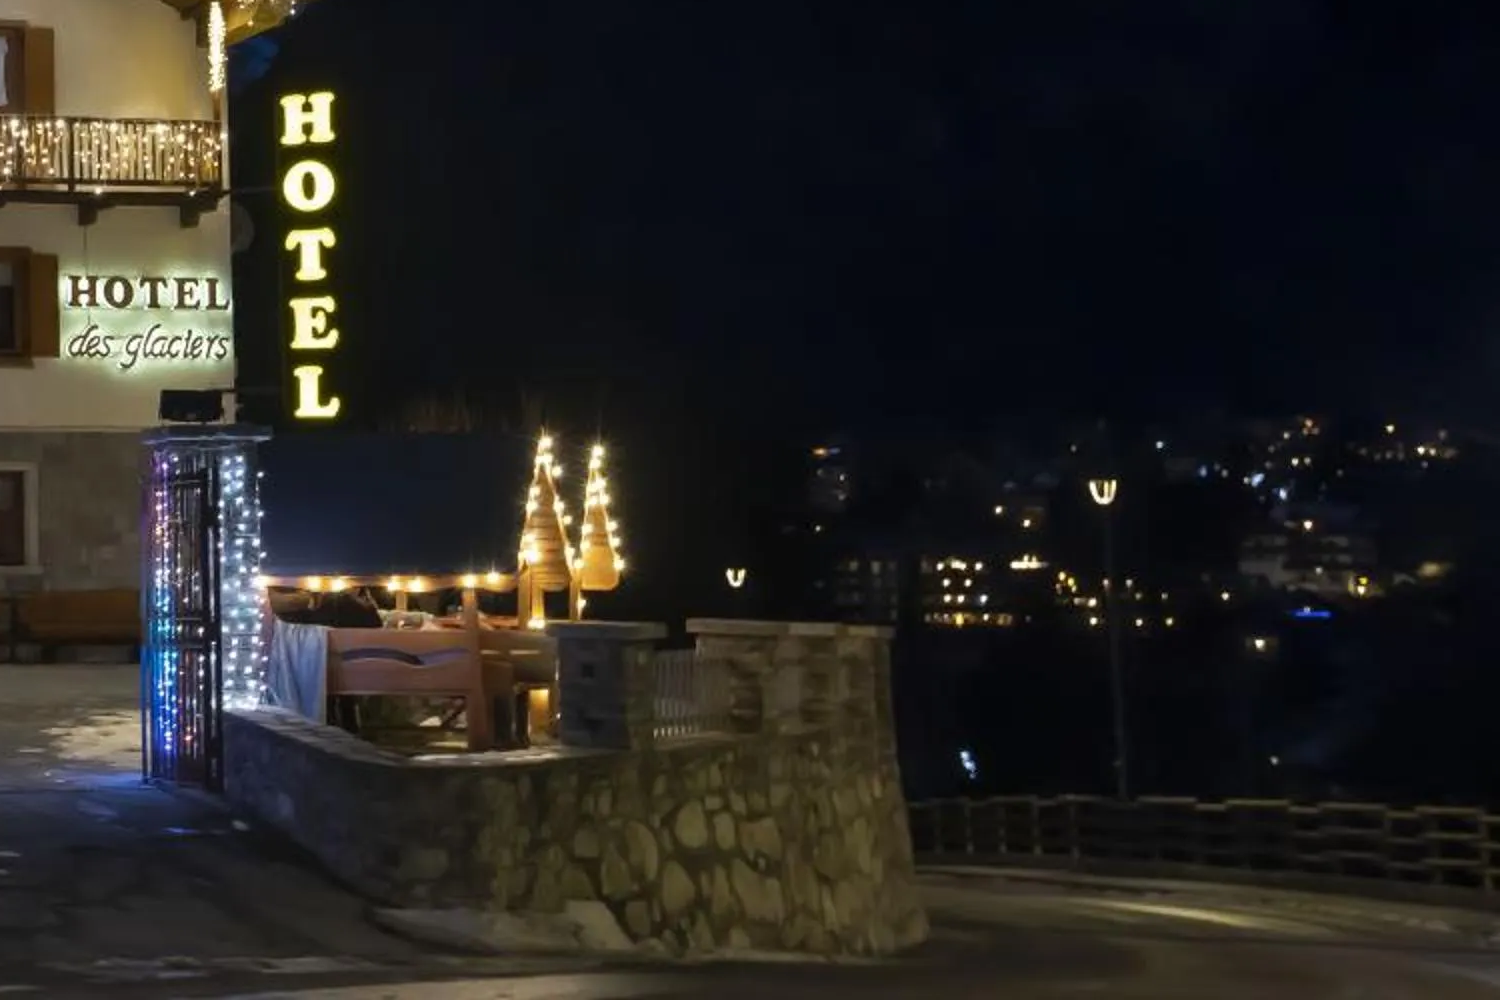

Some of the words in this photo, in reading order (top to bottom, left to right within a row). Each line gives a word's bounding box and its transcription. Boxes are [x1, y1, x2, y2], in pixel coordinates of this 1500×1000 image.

[279, 91, 340, 418] HOTEL
[67, 275, 230, 310] HOTEL
[67, 325, 111, 357] des
[119, 323, 230, 369] glaciers
